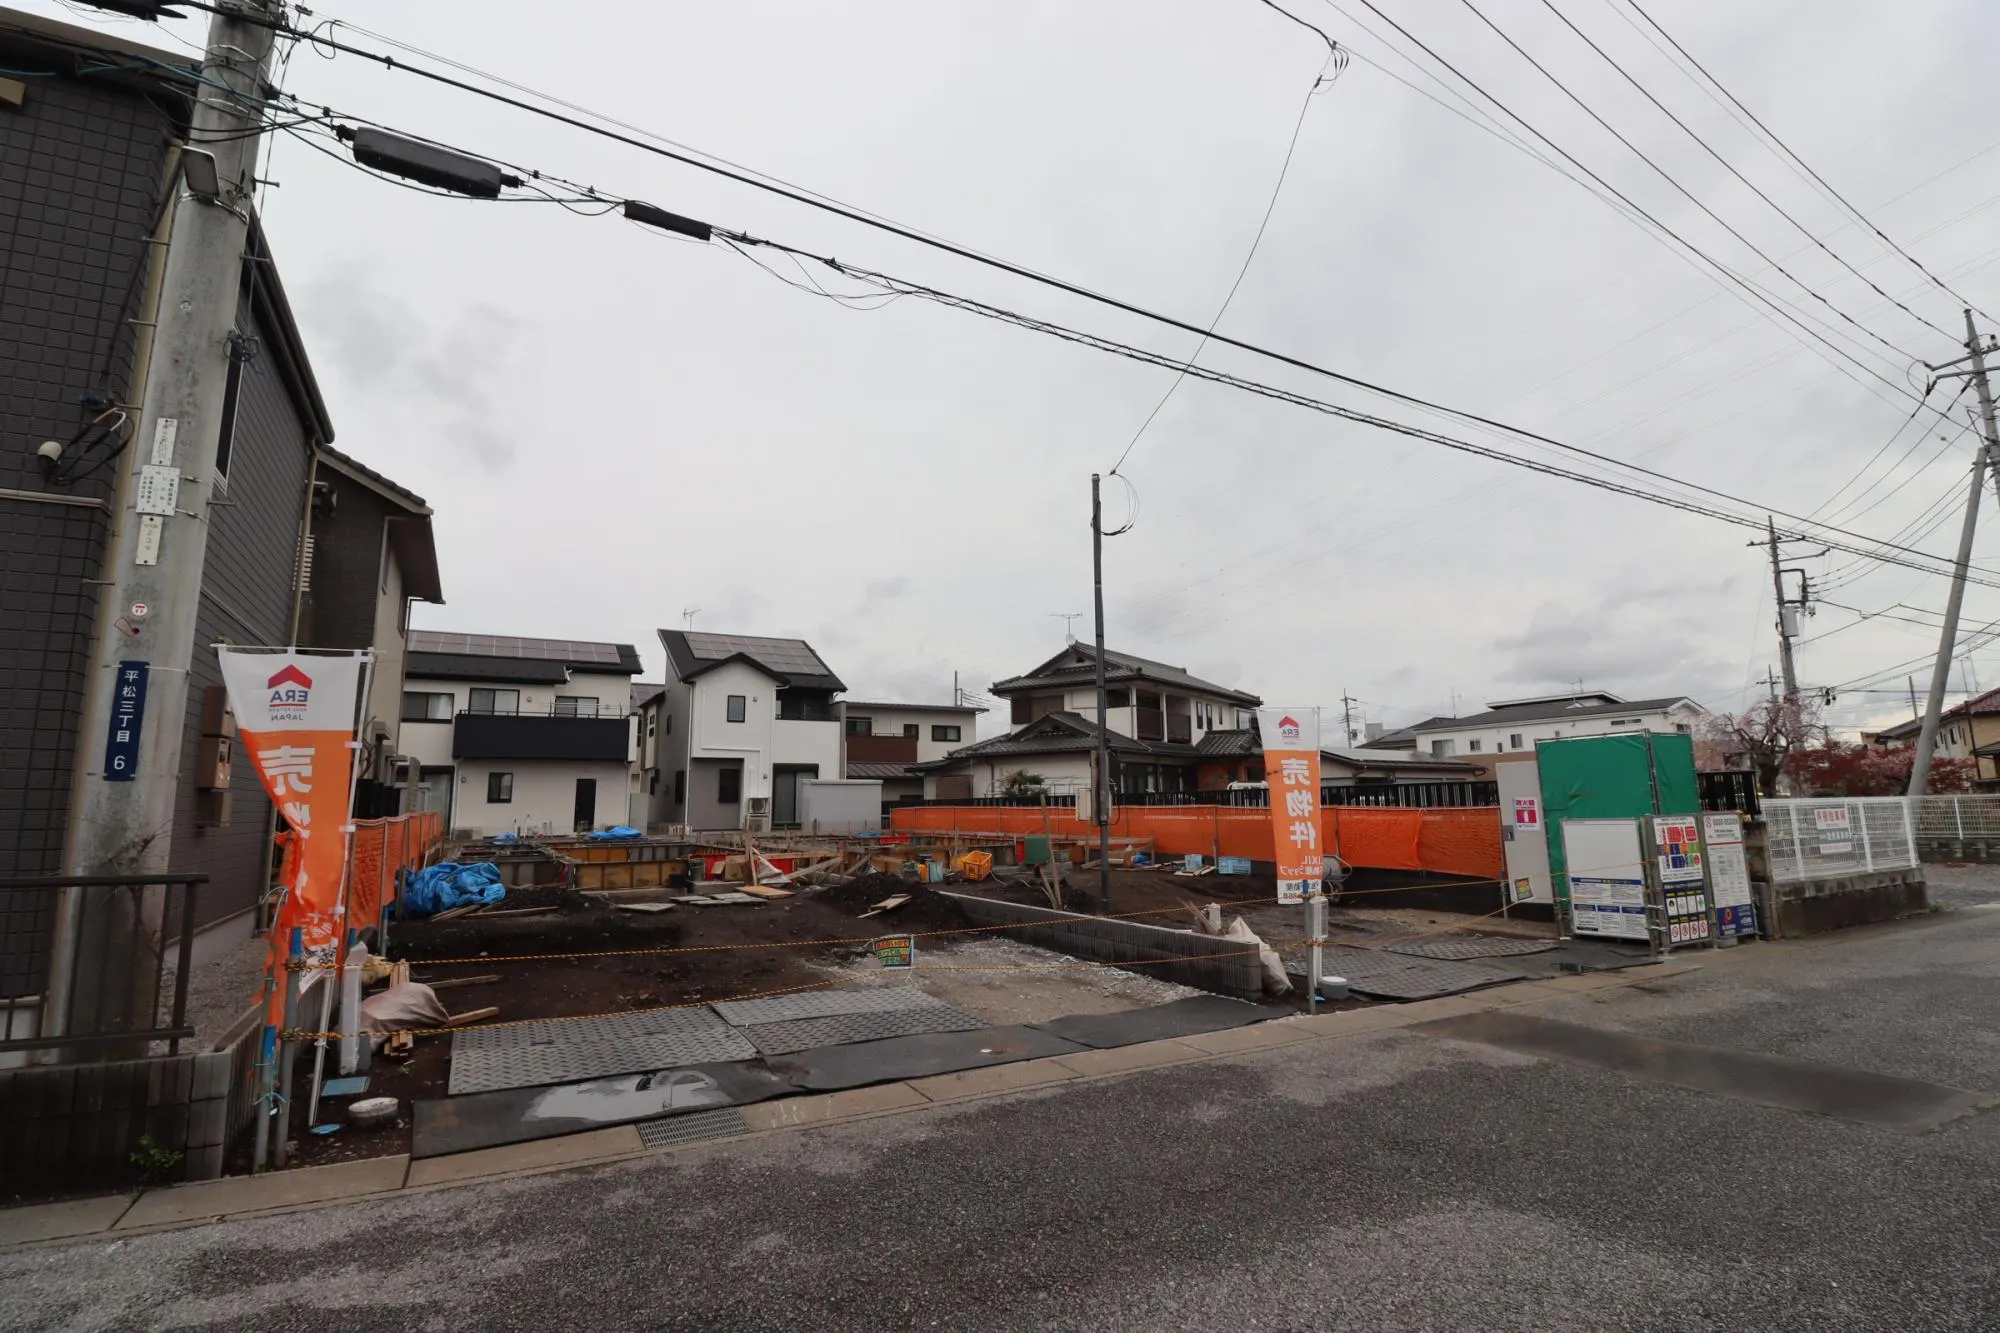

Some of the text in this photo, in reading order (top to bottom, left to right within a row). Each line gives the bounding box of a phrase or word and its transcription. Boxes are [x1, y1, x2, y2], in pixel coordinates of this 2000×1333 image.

[113, 670, 139, 771] 平松三丁目 6
